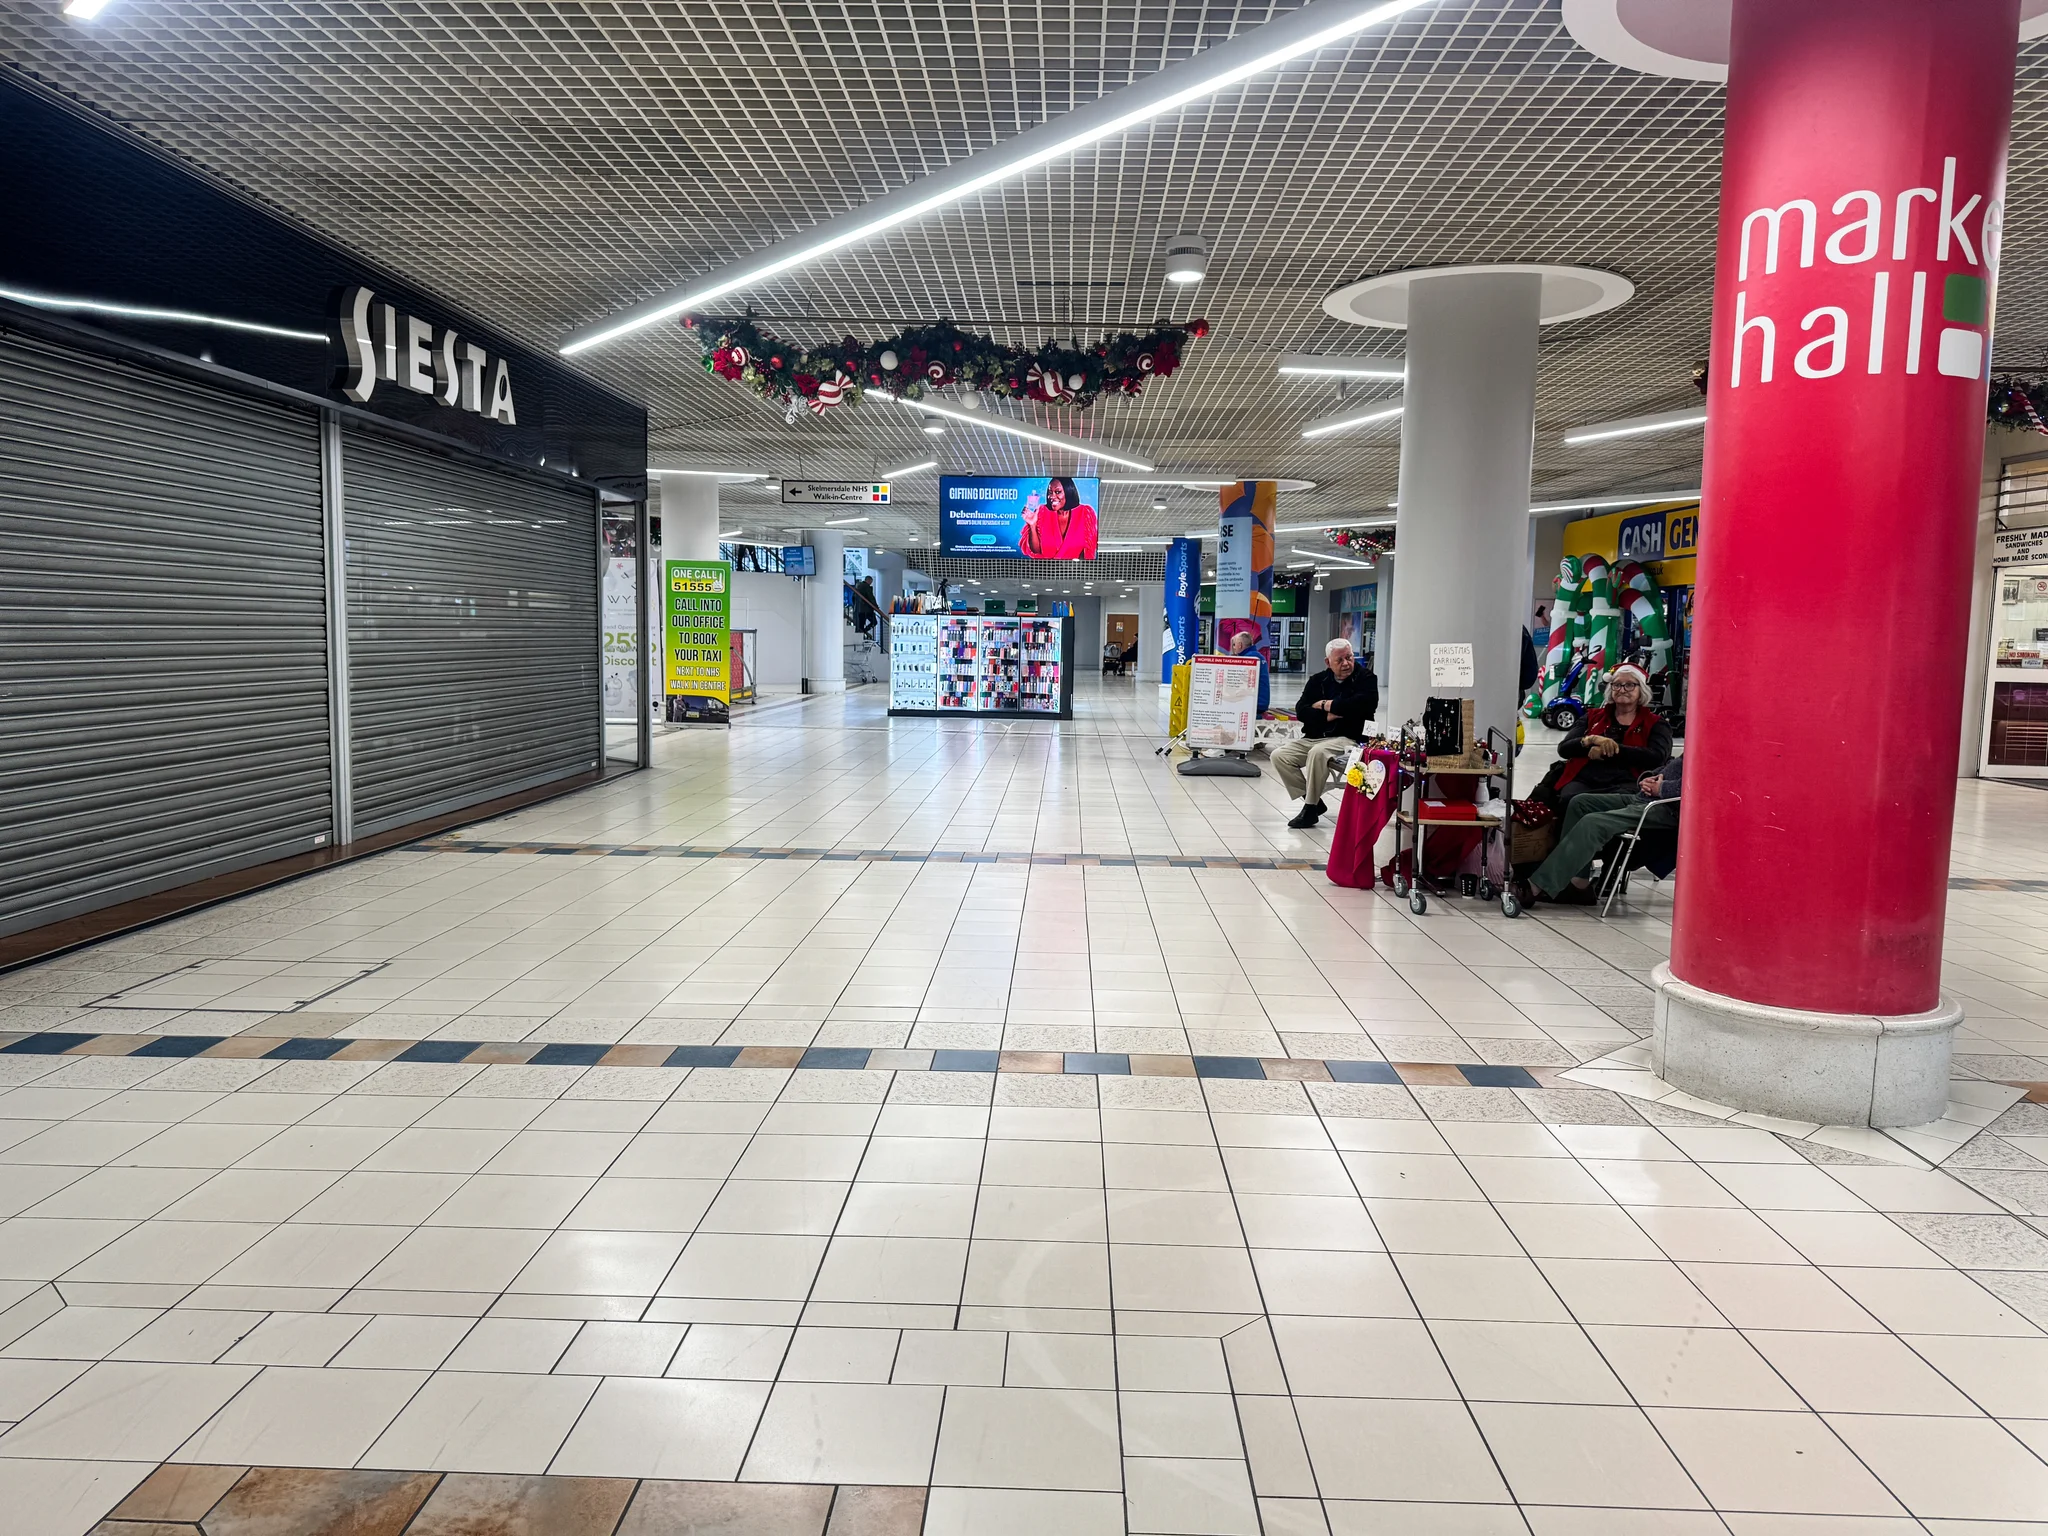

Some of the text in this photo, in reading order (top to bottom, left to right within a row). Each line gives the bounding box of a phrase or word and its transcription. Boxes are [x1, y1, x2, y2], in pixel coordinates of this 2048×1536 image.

[1731, 272, 1927, 388] hall
[341, 286, 516, 426] SIESTA
[807, 484, 850, 493] Skelmersdale
[949, 487, 1018, 500] GIFTING DELIVERED
[813, 493, 862, 501] Walk-in-Centre
[949, 510, 1017, 519] Debenhams.com
[1622, 521, 1662, 555] CASH
[1996, 533, 2027, 543] FRESHLY
[2005, 540, 2043, 549] SANDWICHES
[673, 569, 717, 579] ONE CALL
[1177, 541, 1189, 598] BoyleSports
[674, 582, 712, 591] 51555
[675, 598, 722, 612] CALL INTO
[672, 615, 724, 628] OUR OFFICE
[679, 632, 718, 645] TO BOOK
[674, 649, 722, 661] YOUR TAXI
[1433, 646, 1471, 655] CHRISTMAS
[2017, 651, 2040, 659] SMOKING
[676, 666, 720, 677] NEXT TO NHS
[670, 680, 727, 691] WALK IN CENTRE
